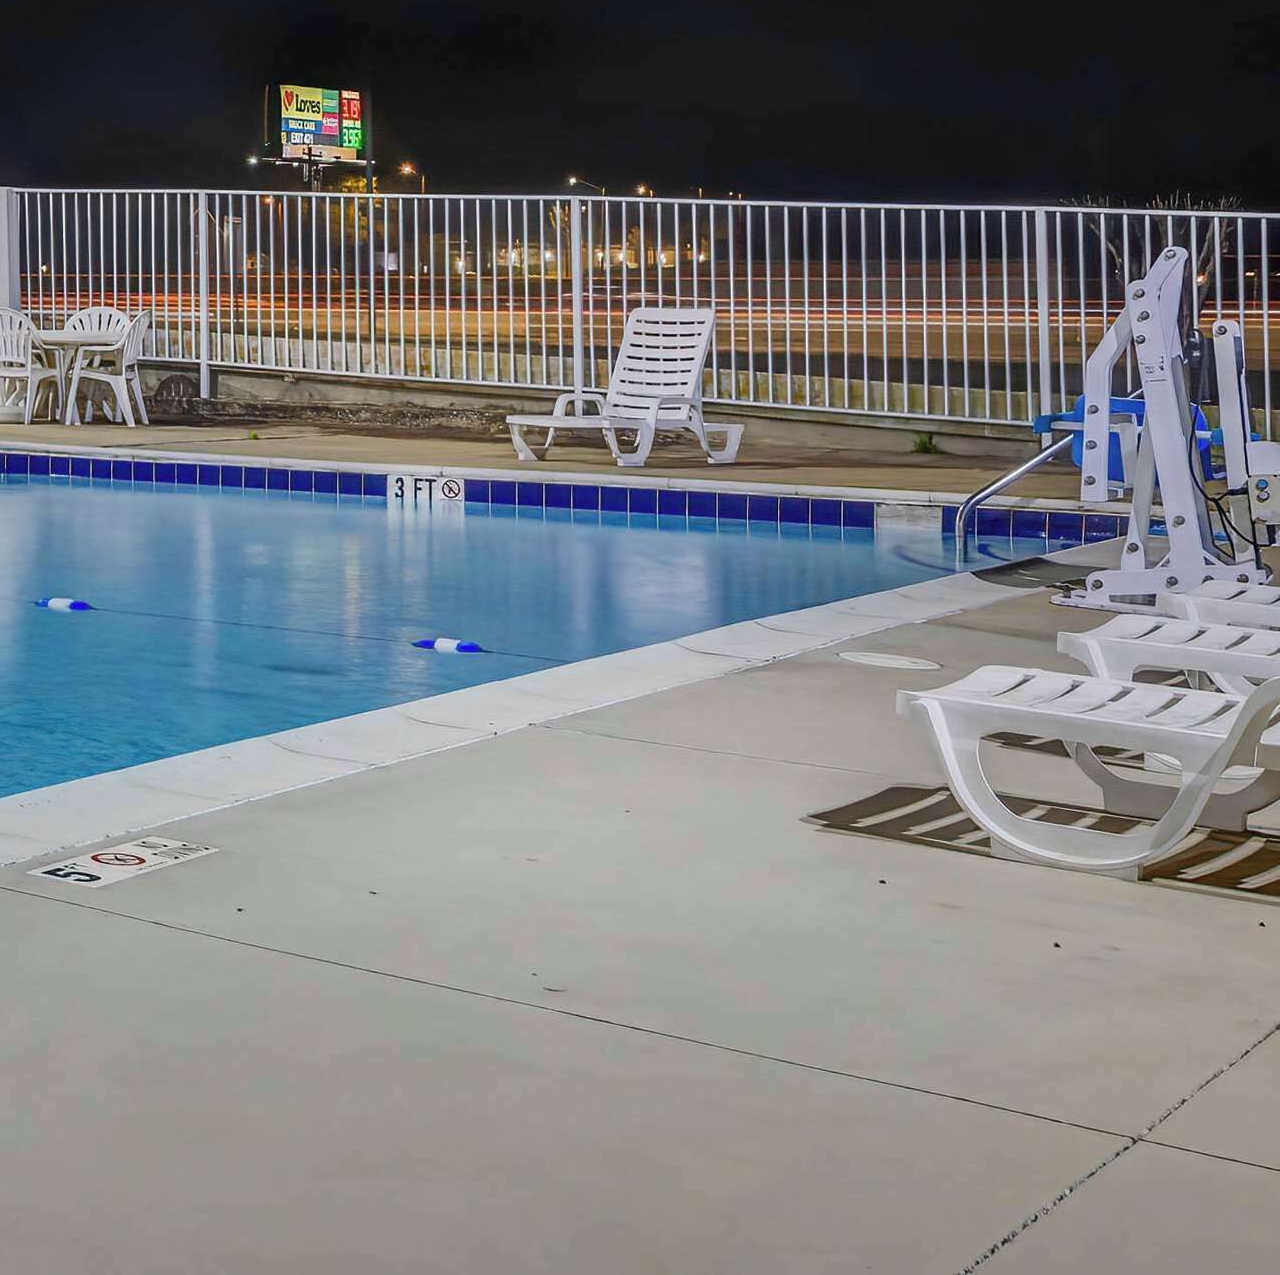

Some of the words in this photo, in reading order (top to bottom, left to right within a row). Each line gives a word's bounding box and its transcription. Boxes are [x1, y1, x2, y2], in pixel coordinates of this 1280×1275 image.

[394, 477, 405, 498] 3
[414, 478, 437, 501] FT
[41, 867, 102, 883] 5
